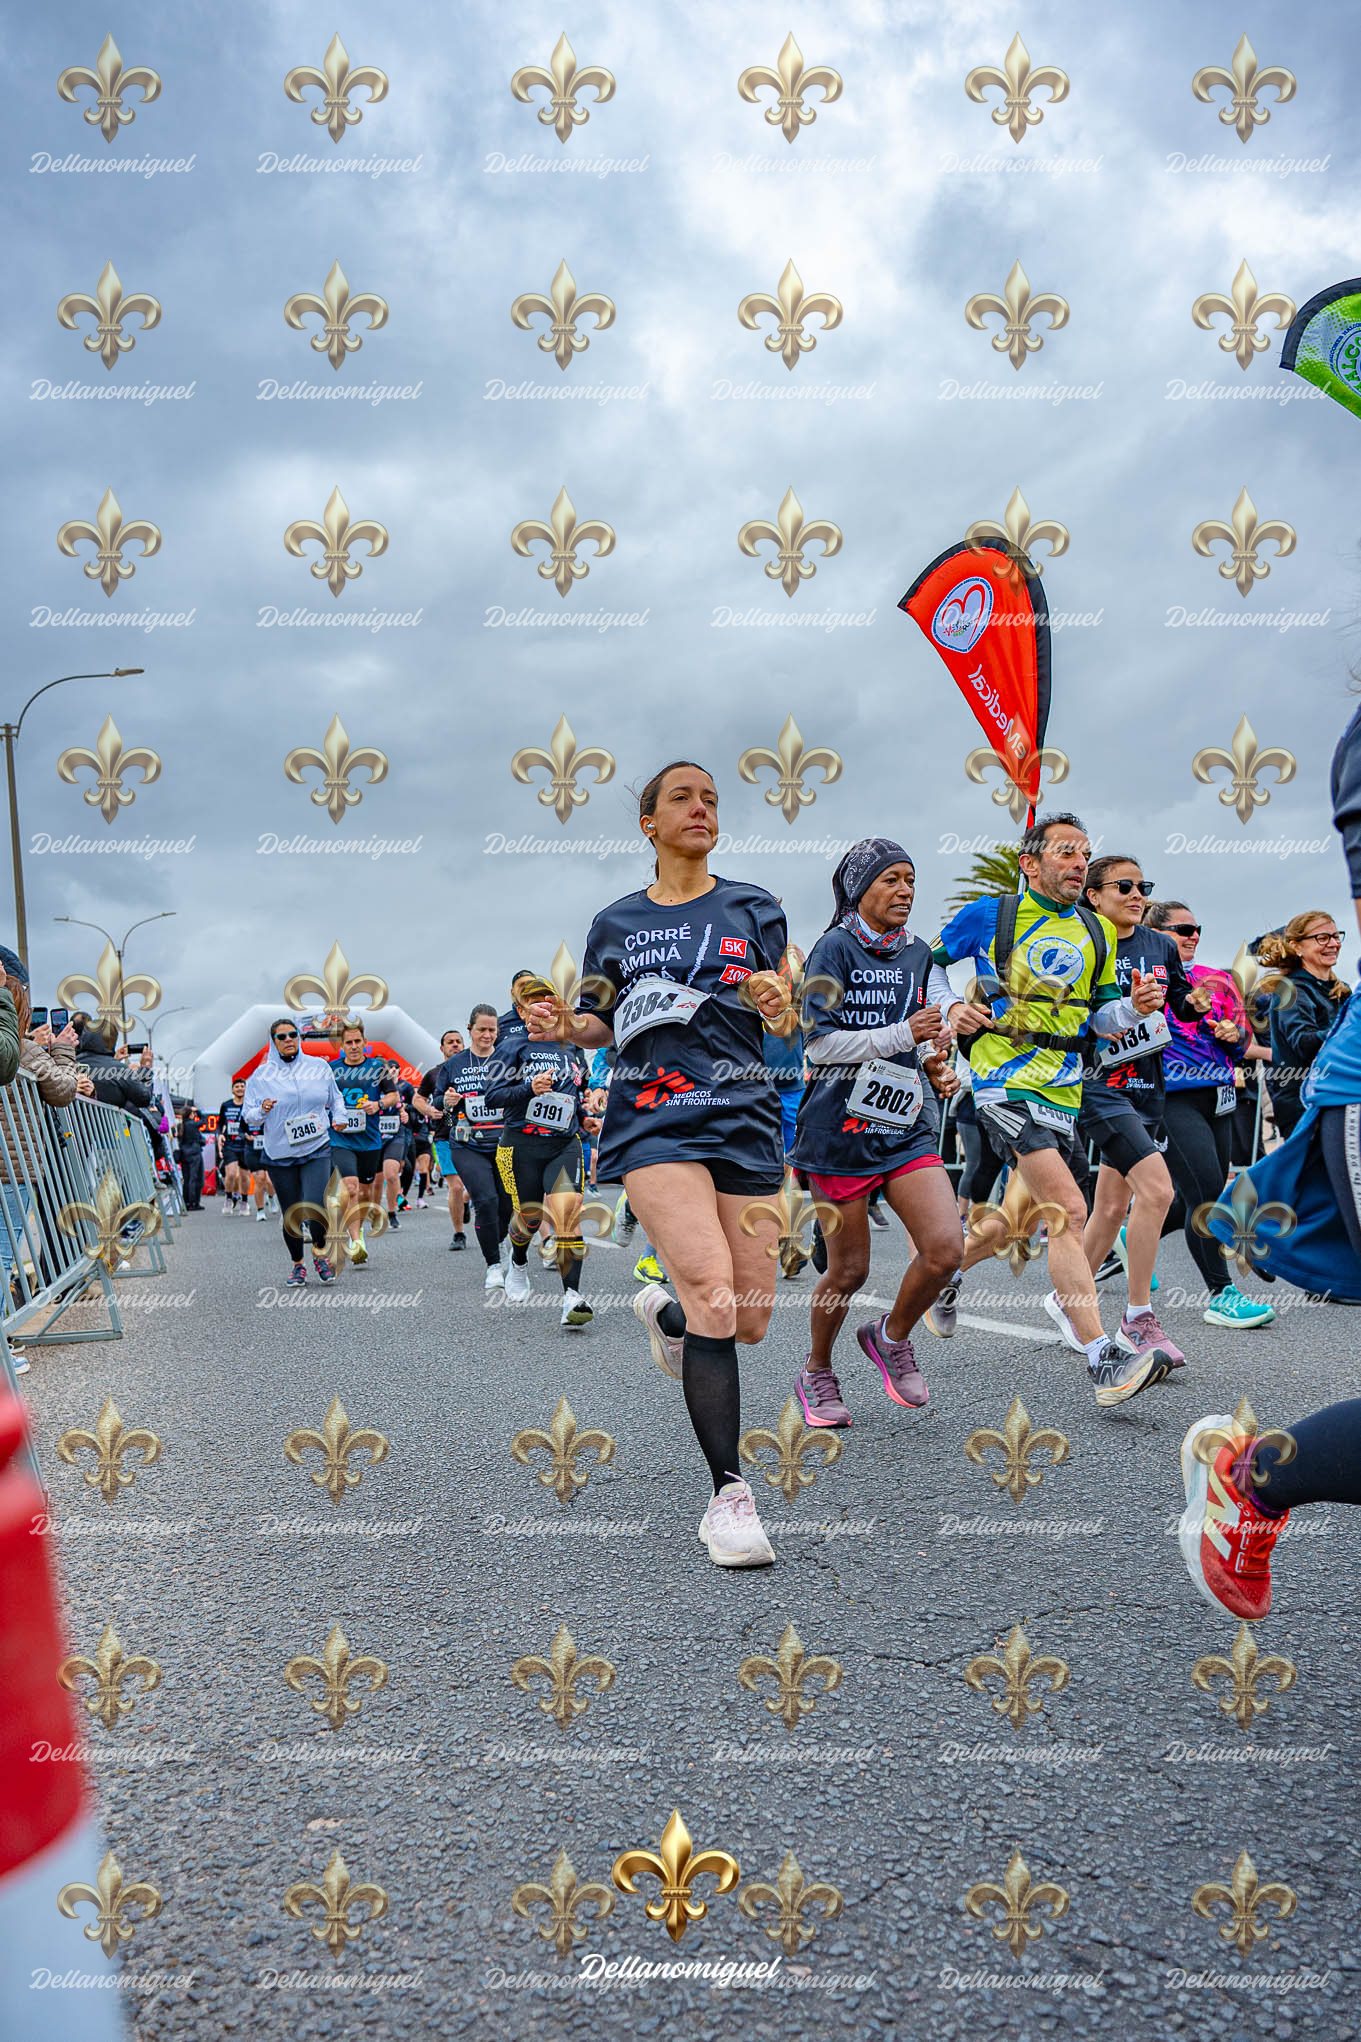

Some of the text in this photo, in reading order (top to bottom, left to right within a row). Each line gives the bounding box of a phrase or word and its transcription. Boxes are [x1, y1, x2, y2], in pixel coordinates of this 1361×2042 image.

[624, 922, 692, 952] CORRÉ
[725, 941, 743, 955] 5K
[619, 942, 682, 979] AMINÁ
[726, 968, 748, 982] 10K
[850, 967, 904, 985] CORRÉ
[844, 987, 897, 1005] AMINÁ
[621, 991, 680, 1032] 2384
[665, 1097, 730, 1107] SIN FRONTERAS
[861, 1080, 915, 1117] 2802
[533, 1102, 563, 1121] 3191
[292, 1122, 316, 1139] 2346
